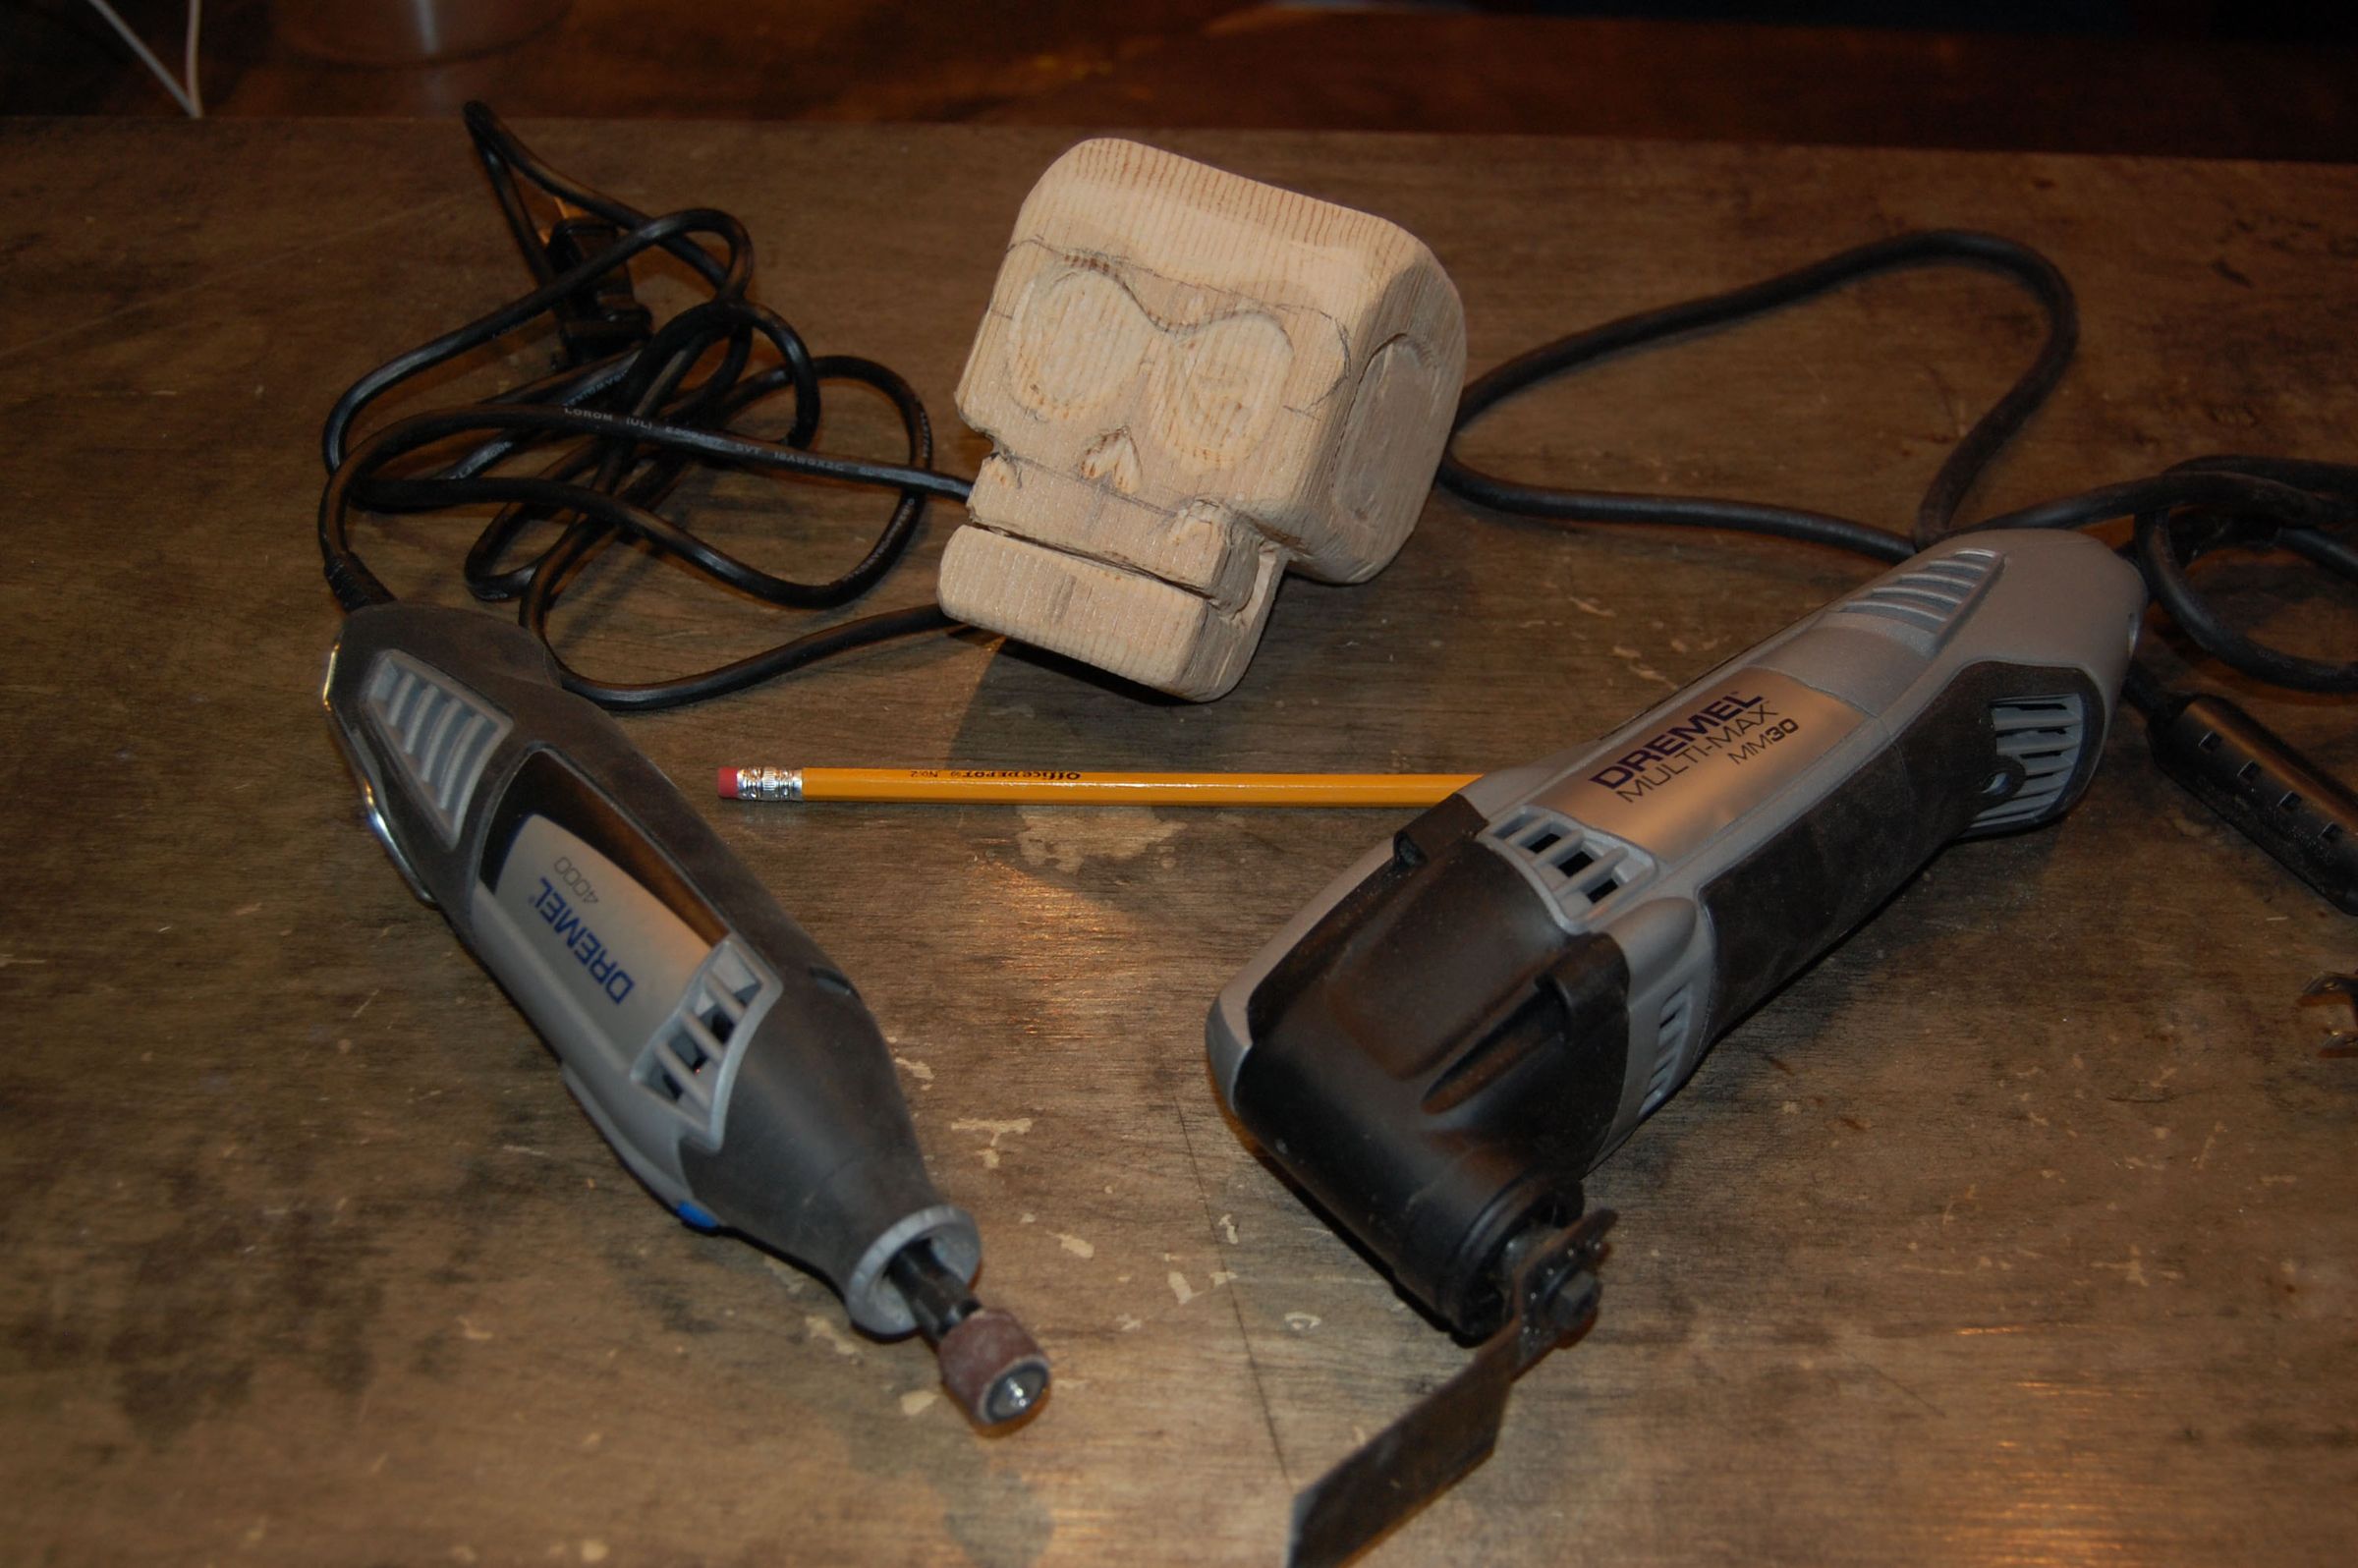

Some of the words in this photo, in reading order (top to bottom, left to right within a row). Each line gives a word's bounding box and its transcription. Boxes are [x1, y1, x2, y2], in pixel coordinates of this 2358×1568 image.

[626, 417, 653, 431] (UL)
[1588, 696, 1765, 790] DREMEL
[1616, 704, 1779, 804] MULTI-MAX
[1728, 718, 1800, 765] MM30
[553, 856, 599, 904] 4000
[533, 876, 636, 1005] DREMEL
